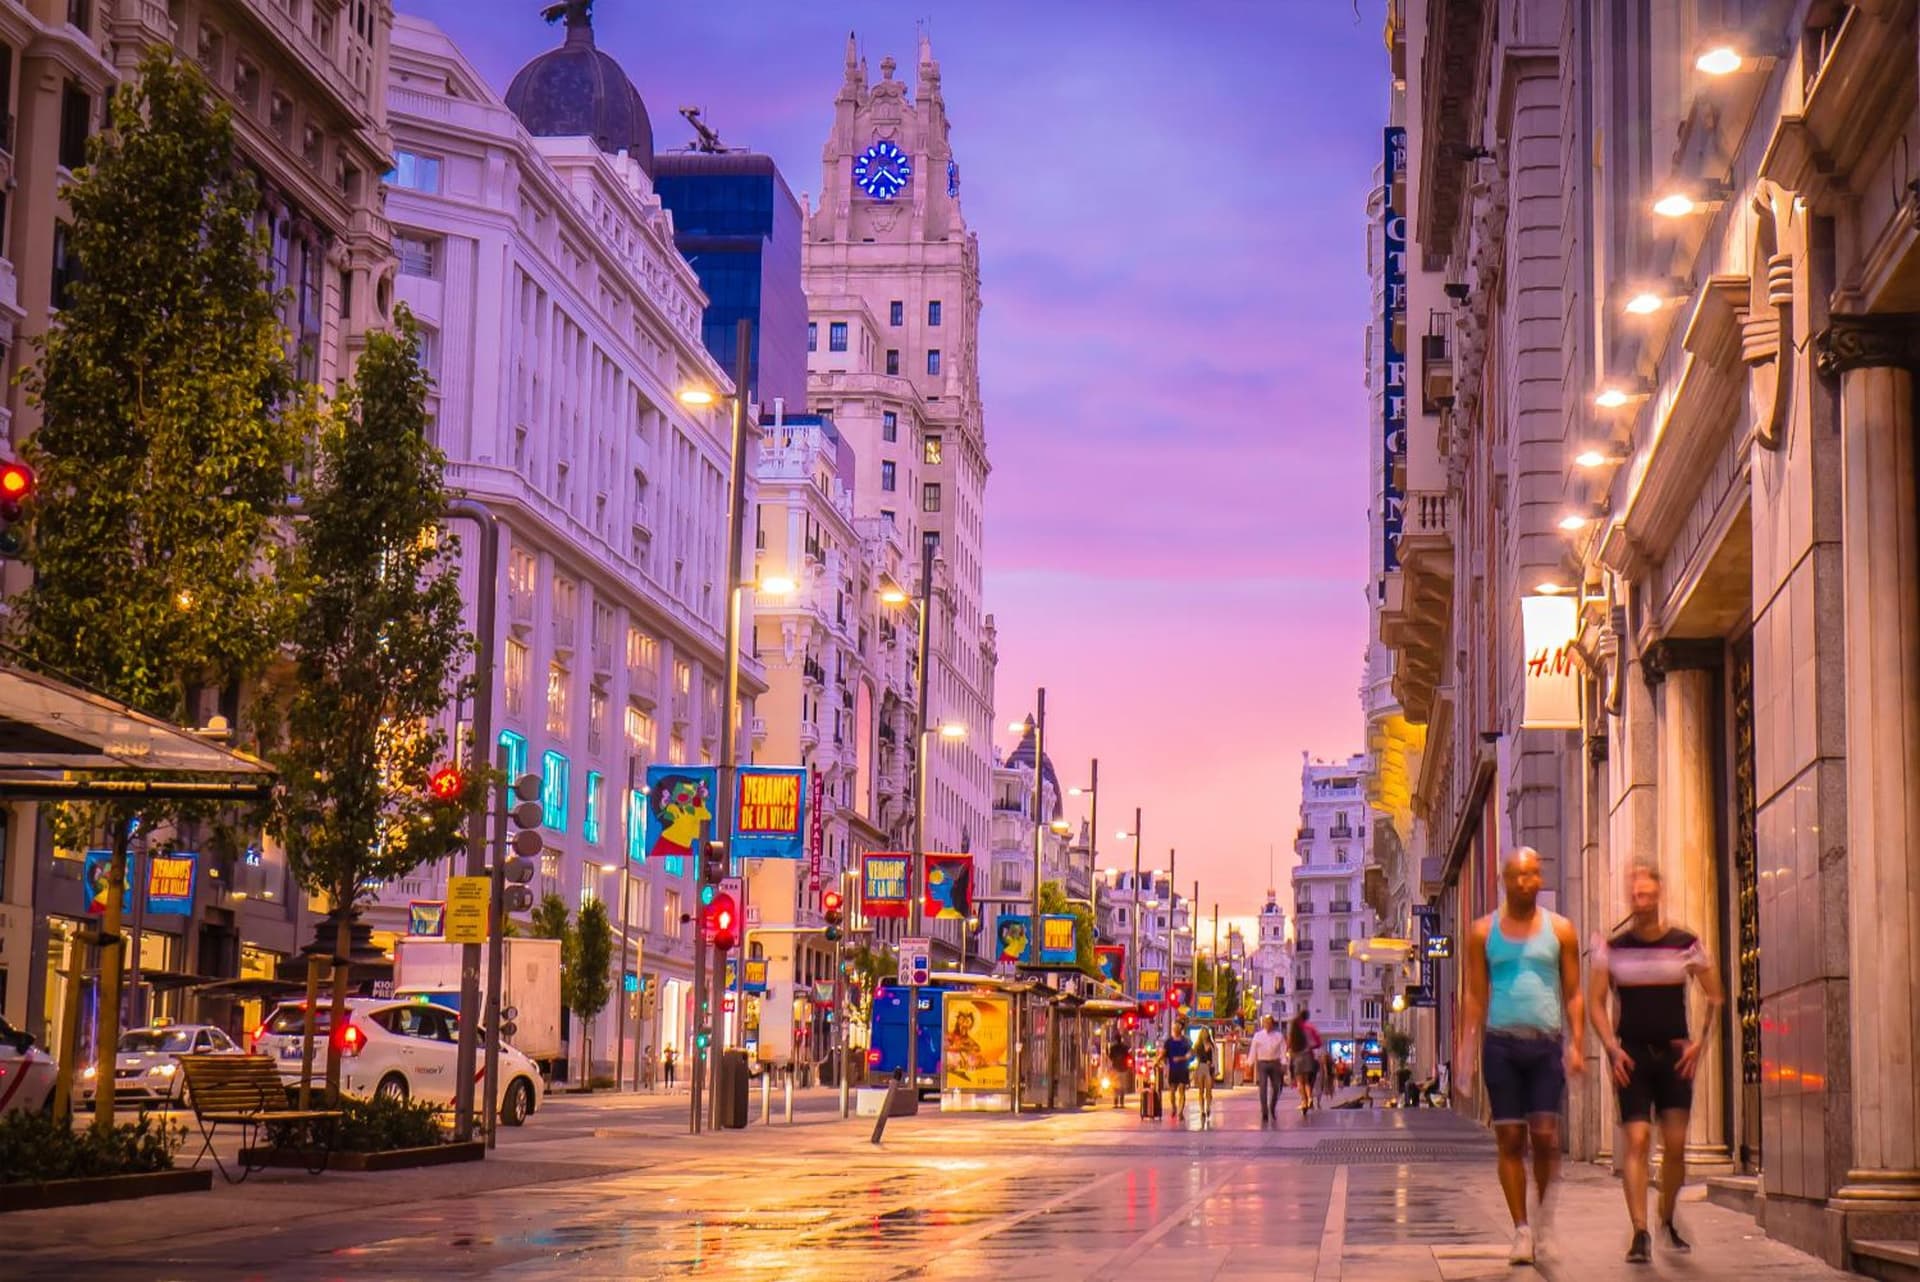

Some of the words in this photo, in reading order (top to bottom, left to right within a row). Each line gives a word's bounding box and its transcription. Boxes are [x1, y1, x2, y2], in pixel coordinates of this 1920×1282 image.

[1528, 647, 1573, 677] H&M
[743, 775, 798, 806] VERANOS
[814, 777, 822, 818] PETIT
[741, 805, 754, 831] DE
[756, 805, 768, 831] LA
[769, 805, 796, 832] VILLA
[812, 821, 820, 873] PALACE
[152, 858, 192, 879] VERANOS
